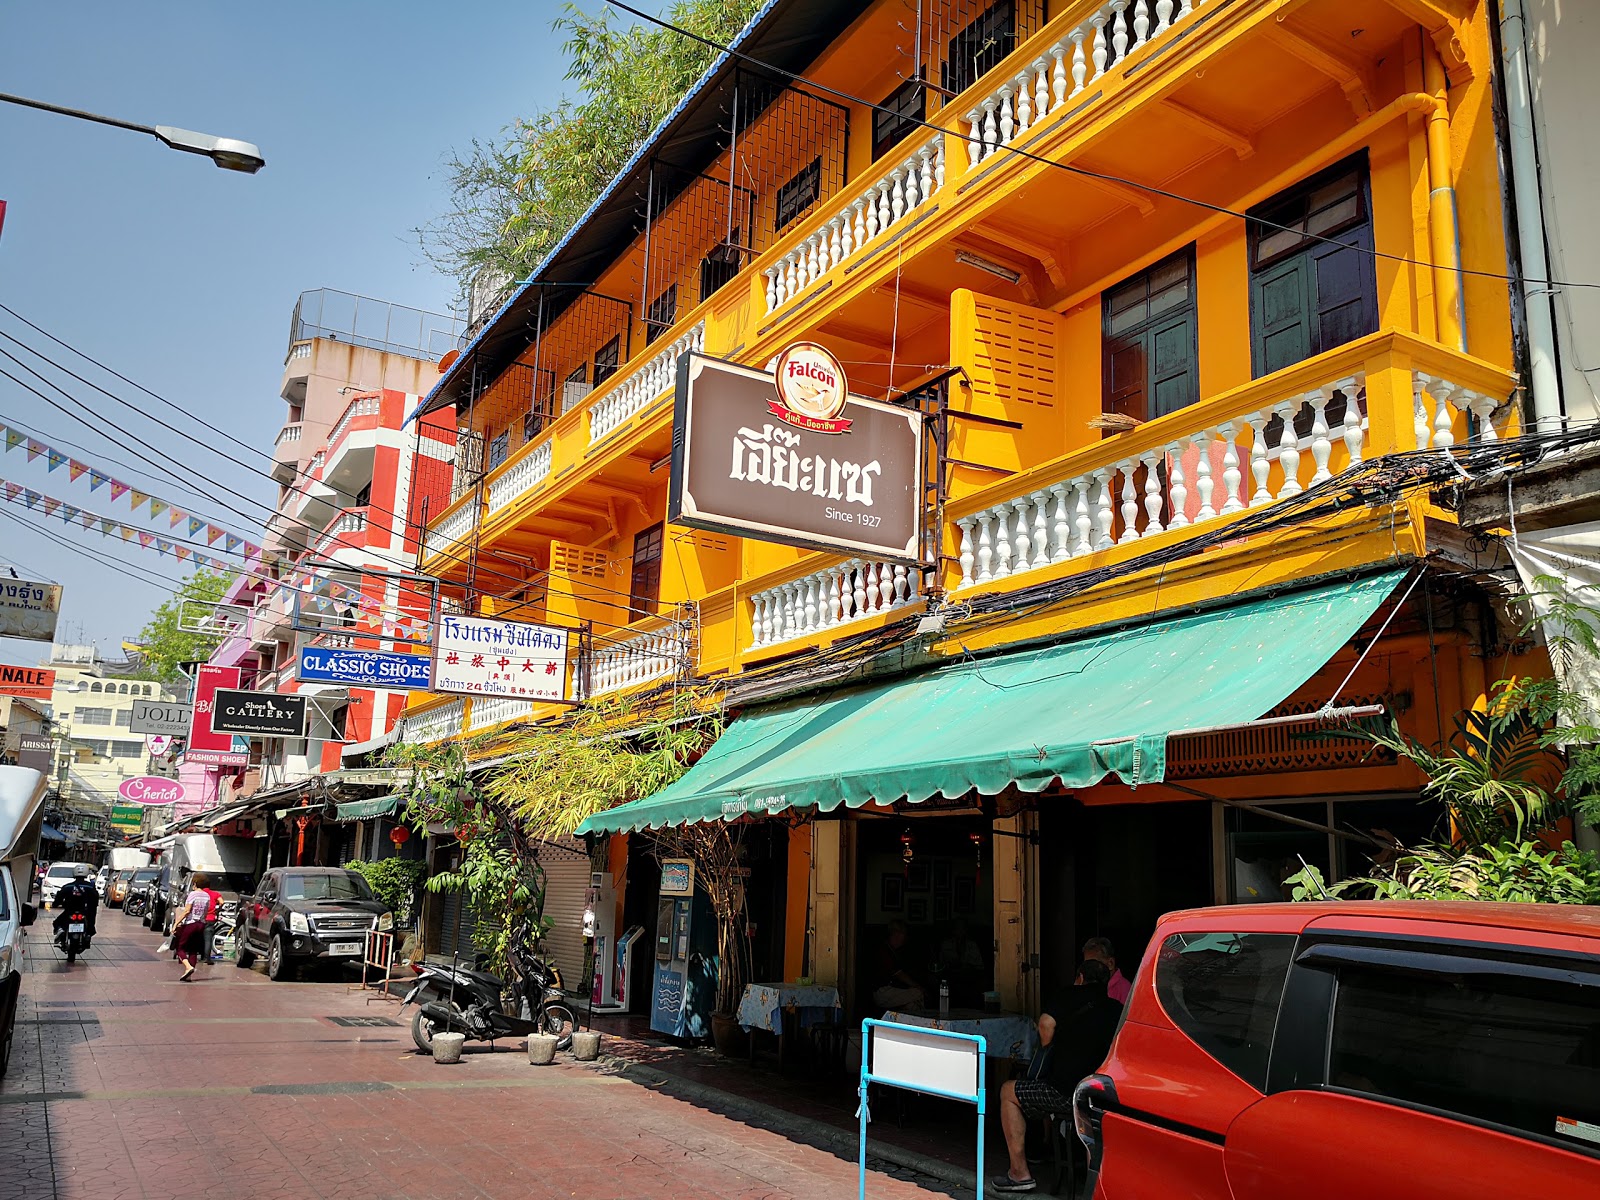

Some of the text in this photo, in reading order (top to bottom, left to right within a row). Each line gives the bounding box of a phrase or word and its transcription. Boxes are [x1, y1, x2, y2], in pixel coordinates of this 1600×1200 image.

[788, 361, 835, 388] Falcon
[825, 507, 882, 528] Since 1927
[0, 581, 44, 605] งรุ้ง
[8, 602, 42, 610] RUNG
[303, 655, 431, 679] CLASSIC SHOES
[0, 667, 47, 686] NALE
[439, 677, 465, 690] บริการ
[466, 682, 483, 691] 24
[484, 681, 507, 693] ชั่วโมง
[137, 706, 192, 723] JOLL
[226, 706, 295, 719] GALLERY
[245, 701, 266, 710] Shoes
[187, 753, 246, 764] FASHION SHOES
[126, 778, 178, 800] Cherich
